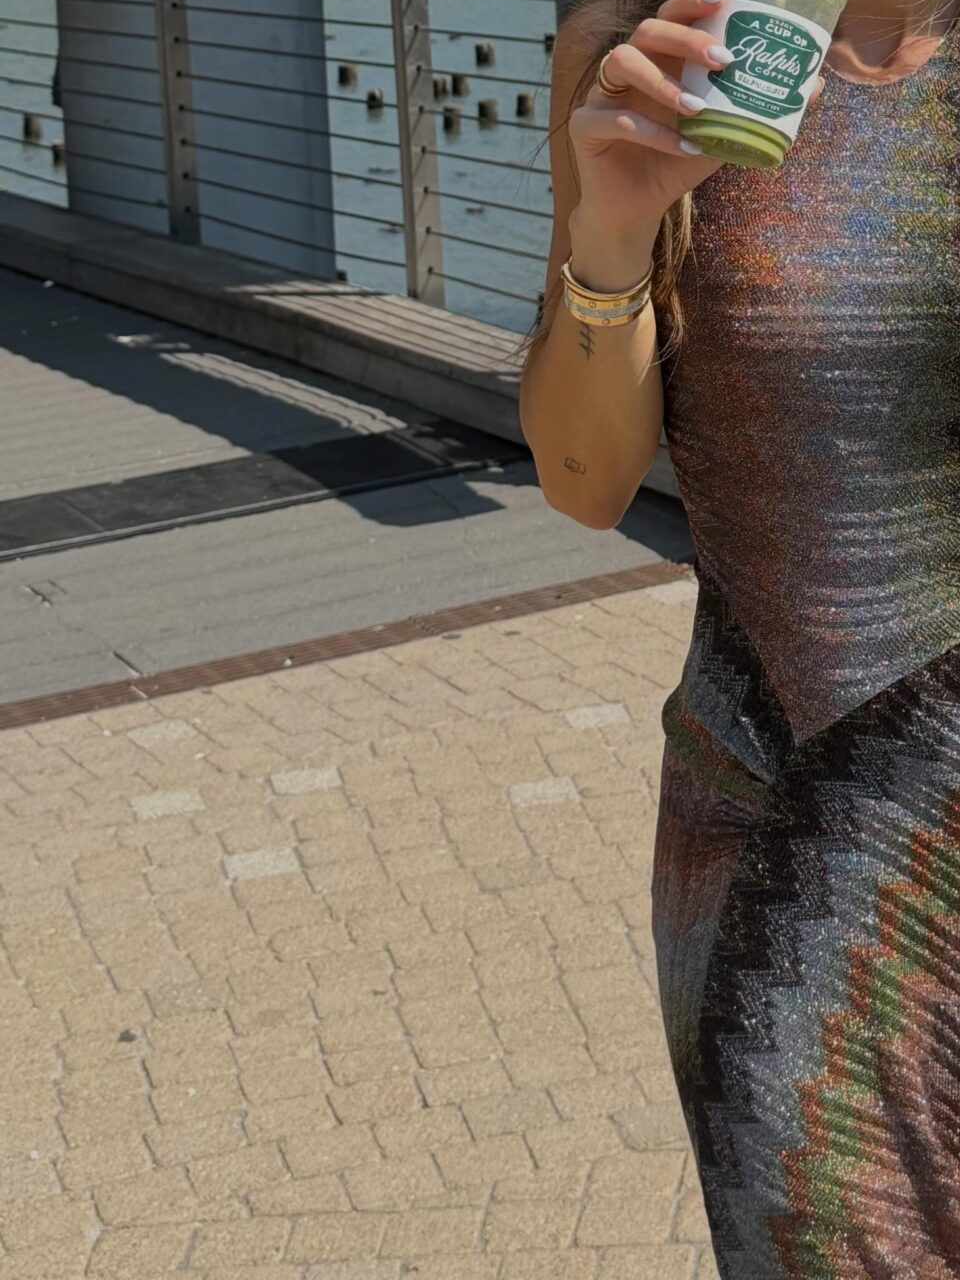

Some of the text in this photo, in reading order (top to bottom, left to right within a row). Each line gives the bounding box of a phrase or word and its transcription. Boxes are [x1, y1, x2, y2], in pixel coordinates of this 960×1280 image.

[750, 20, 760, 30] A
[765, 23, 791, 37] CUP
[730, 35, 801, 75] Ralph's
[754, 66, 796, 86] COFFEE
